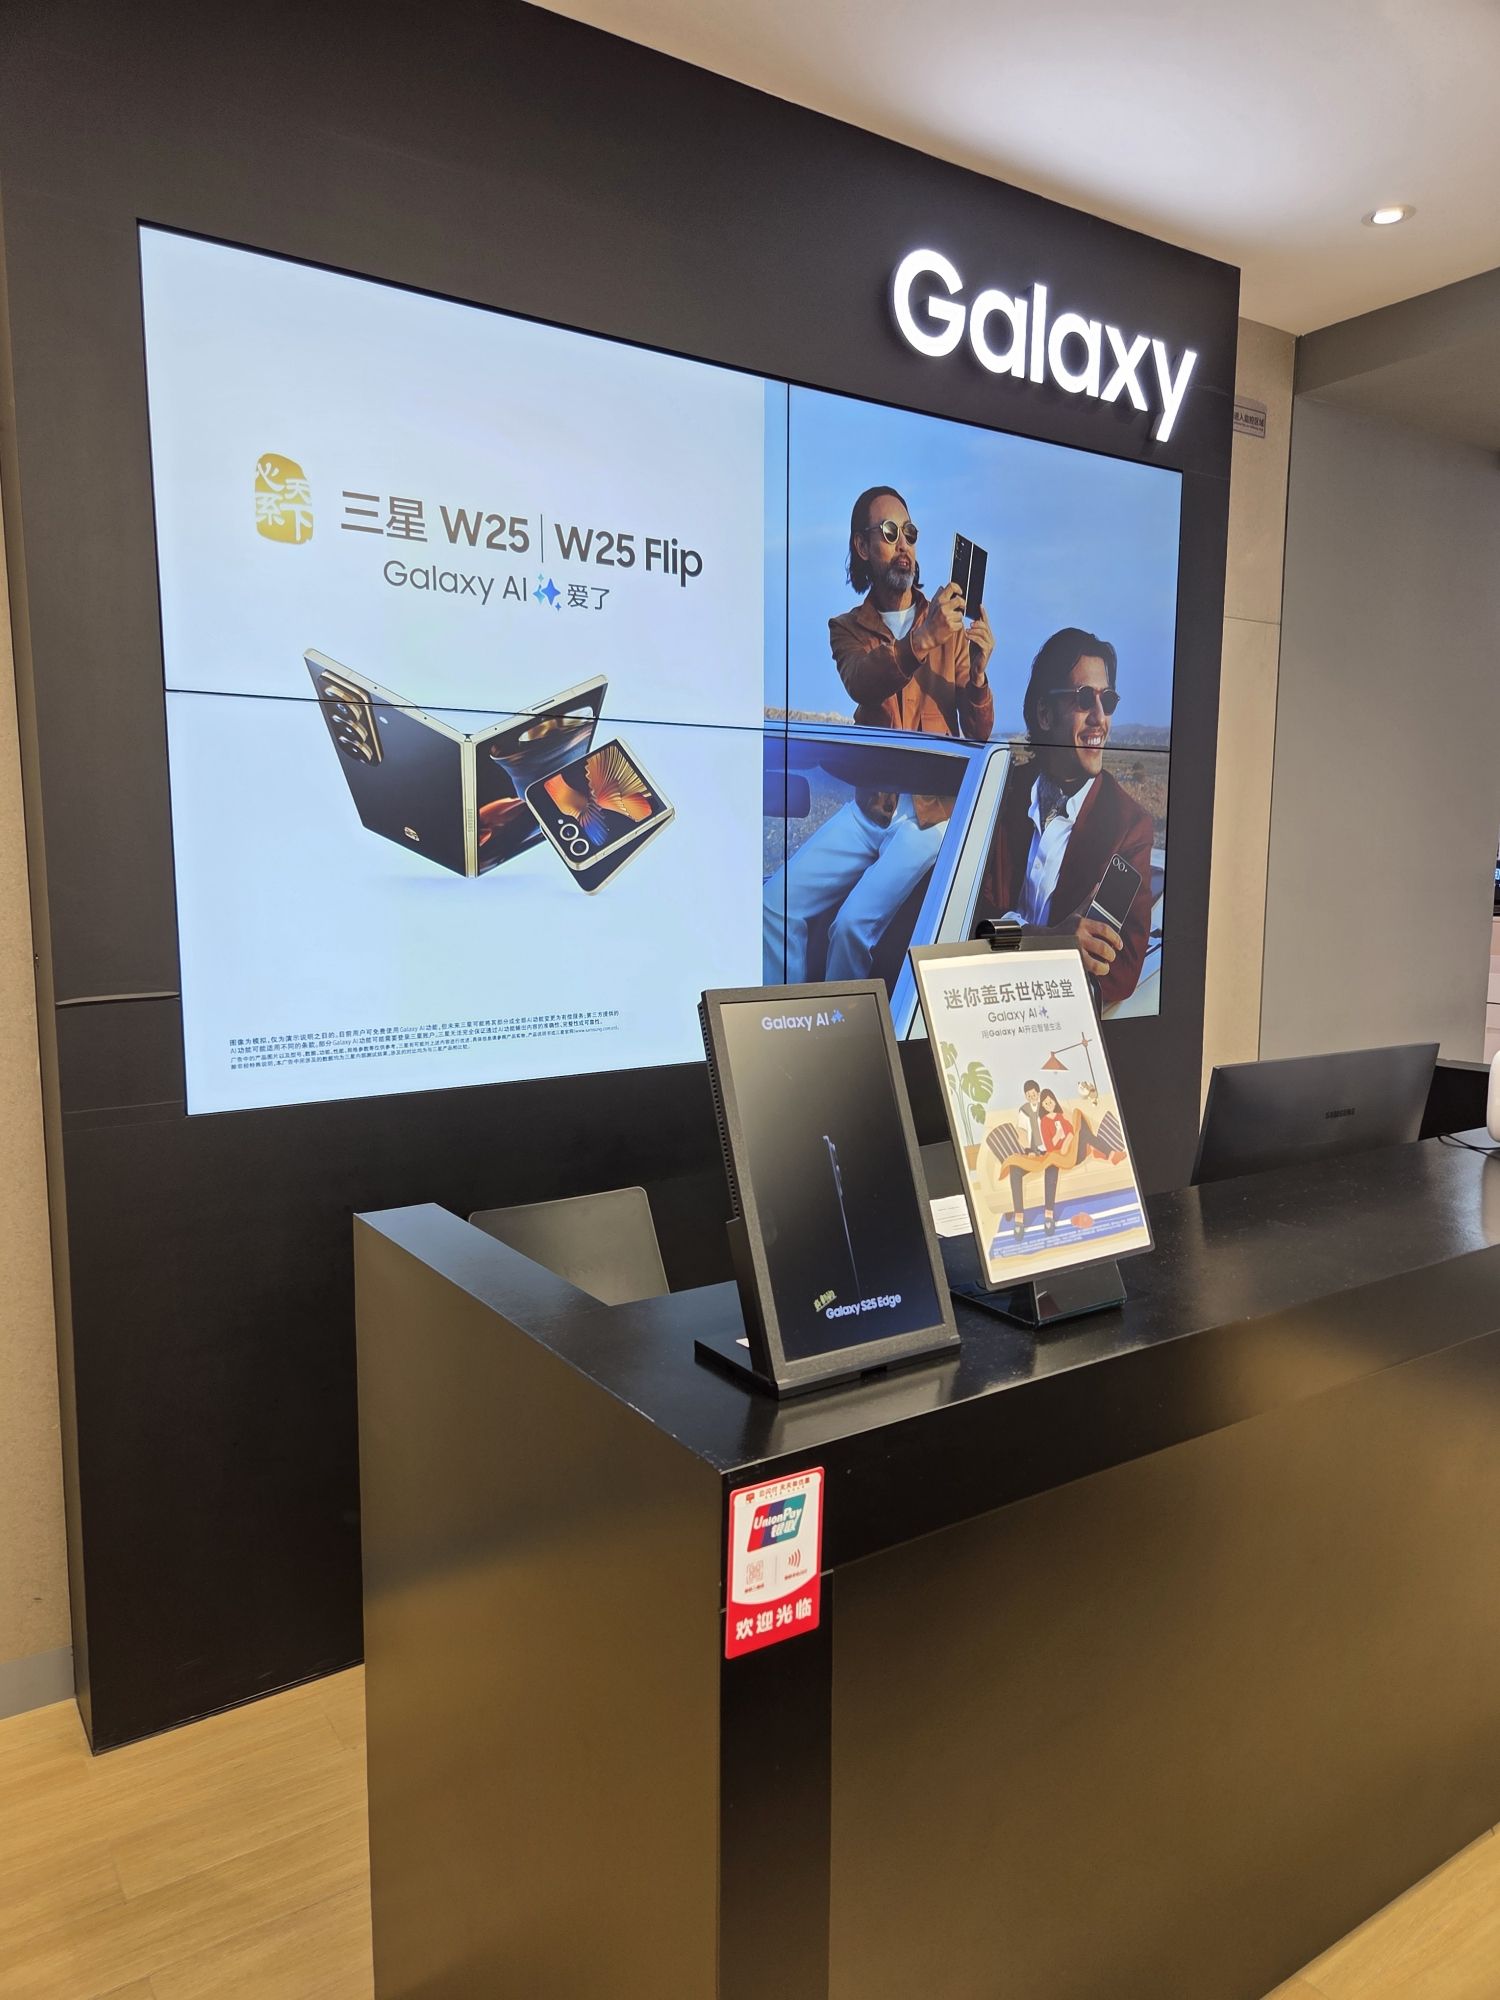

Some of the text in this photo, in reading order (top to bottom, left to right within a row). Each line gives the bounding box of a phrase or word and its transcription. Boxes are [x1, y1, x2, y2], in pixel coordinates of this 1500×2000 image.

[893, 248, 1198, 443] Galaxy
[341, 490, 703, 588] 三星 W25 W25 Flip
[383, 560, 610, 610] Galaxy AI 爱了
[943, 978, 1075, 1009] 迷你盖乐世体验堂
[761, 1012, 830, 1032] Galaxy AI
[987, 1008, 1037, 1023] Galaxy AI
[825, 1294, 902, 1319] Galaxy S25 Edge
[753, 1507, 802, 1531] UnionPay
[735, 1597, 813, 1641] 欢迎光临
